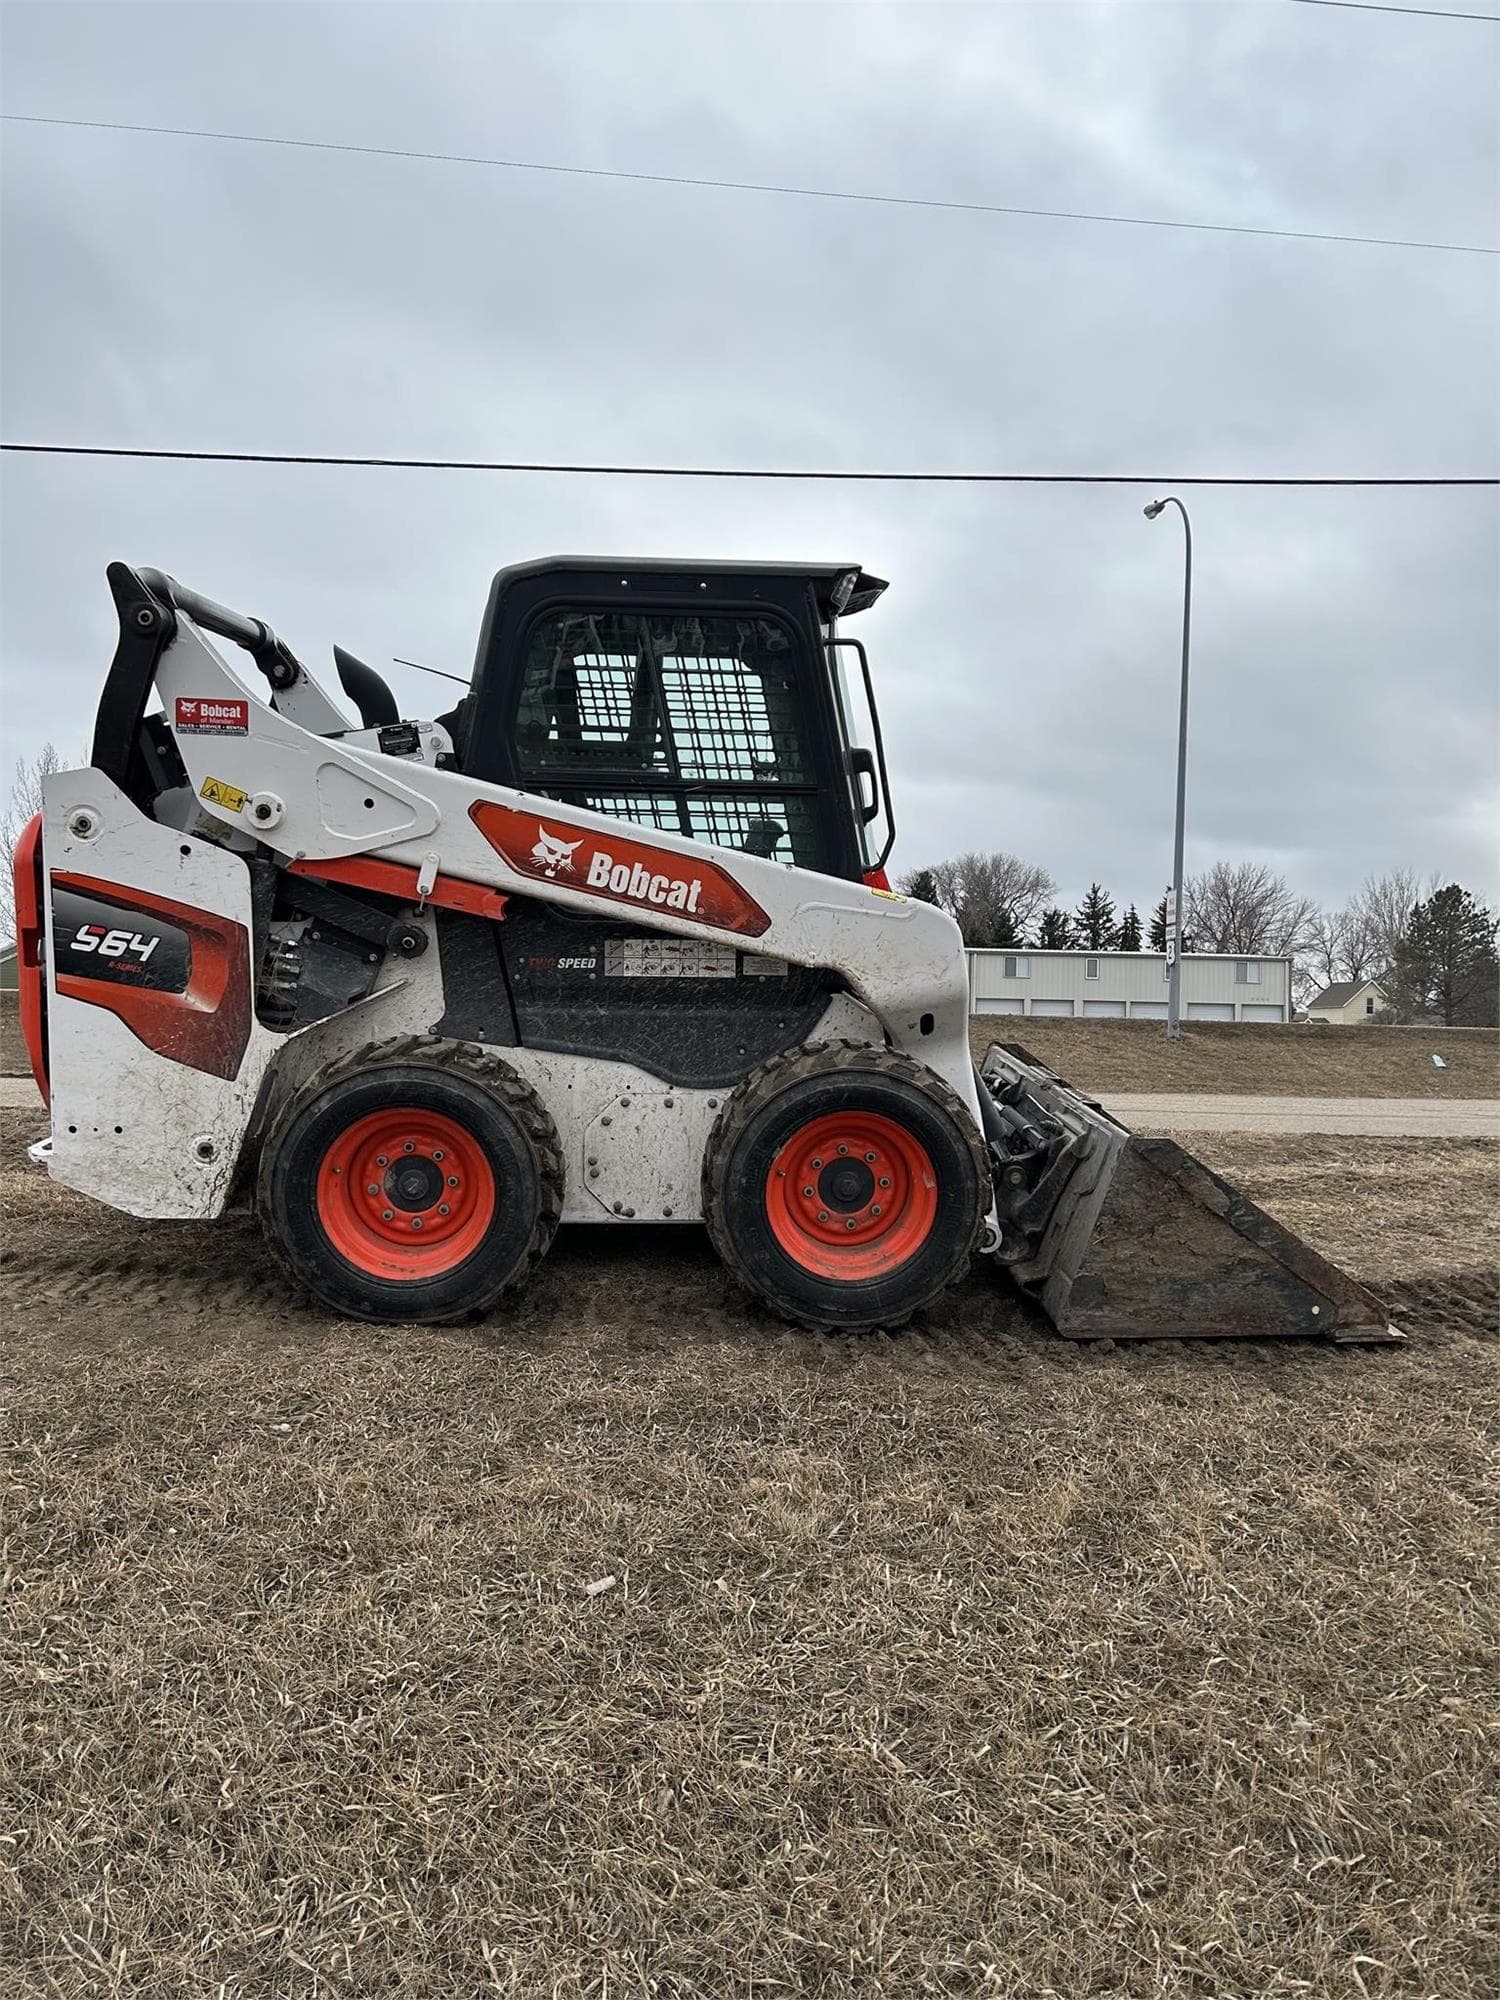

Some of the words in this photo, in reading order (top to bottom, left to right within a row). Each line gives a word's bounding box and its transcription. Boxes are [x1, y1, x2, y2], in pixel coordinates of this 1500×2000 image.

[200, 703, 241, 718] Bobcat
[586, 851, 702, 913] Bobcat
[70, 924, 160, 962] S64
[108, 961, 142, 973] R-SERIES
[557, 957, 597, 969] SPEED
